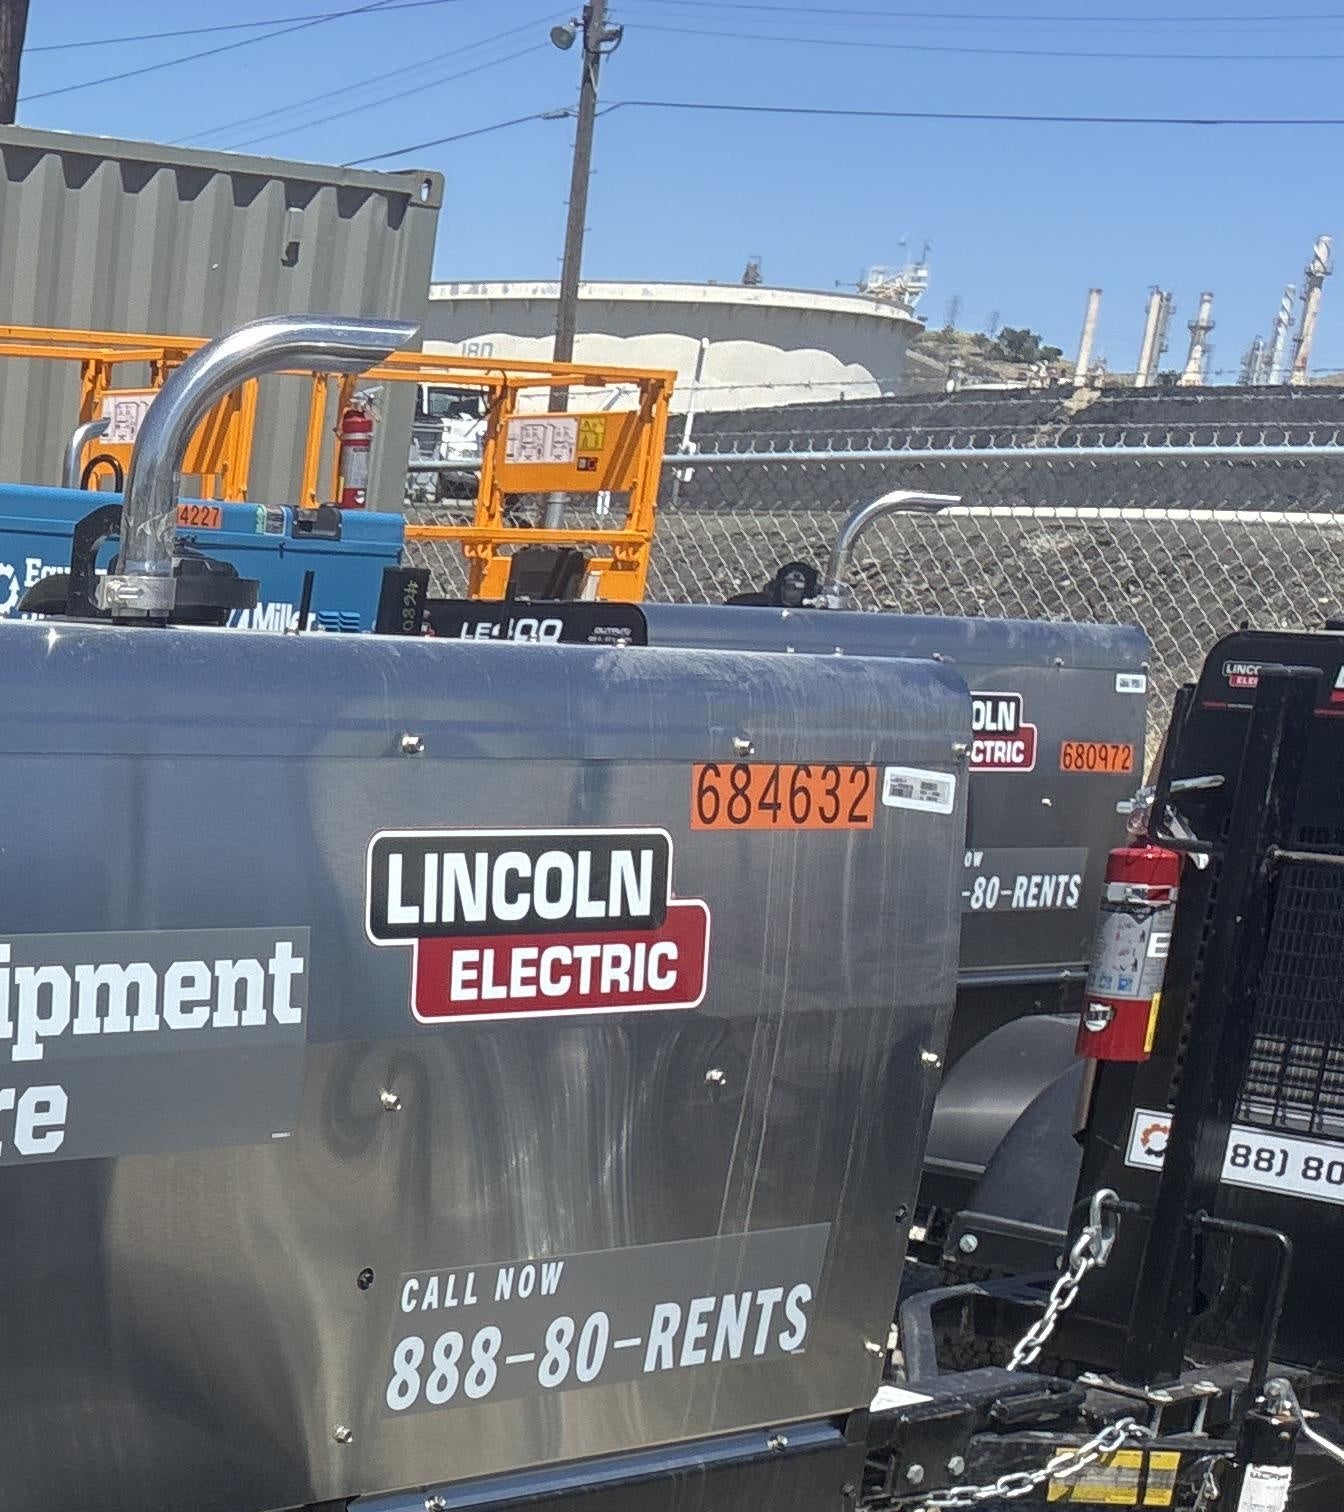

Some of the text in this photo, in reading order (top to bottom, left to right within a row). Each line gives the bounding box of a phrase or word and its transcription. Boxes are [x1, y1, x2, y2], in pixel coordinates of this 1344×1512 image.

[179, 506, 222, 527] 4227
[1226, 664, 1258, 675] LINC
[967, 740, 1025, 764] CTRIC
[1063, 743, 1131, 771] 680972
[696, 763, 870, 824] 684632
[963, 851, 983, 867] OW
[387, 849, 653, 925] LINCOLN
[962, 875, 1082, 909] -80-RENTS
[450, 941, 678, 1001] ELECTRIC
[1230, 1143, 1289, 1177] 88)
[400, 1261, 565, 1313] CALL NOW
[385, 1283, 812, 1411] 888-80-RENTS
